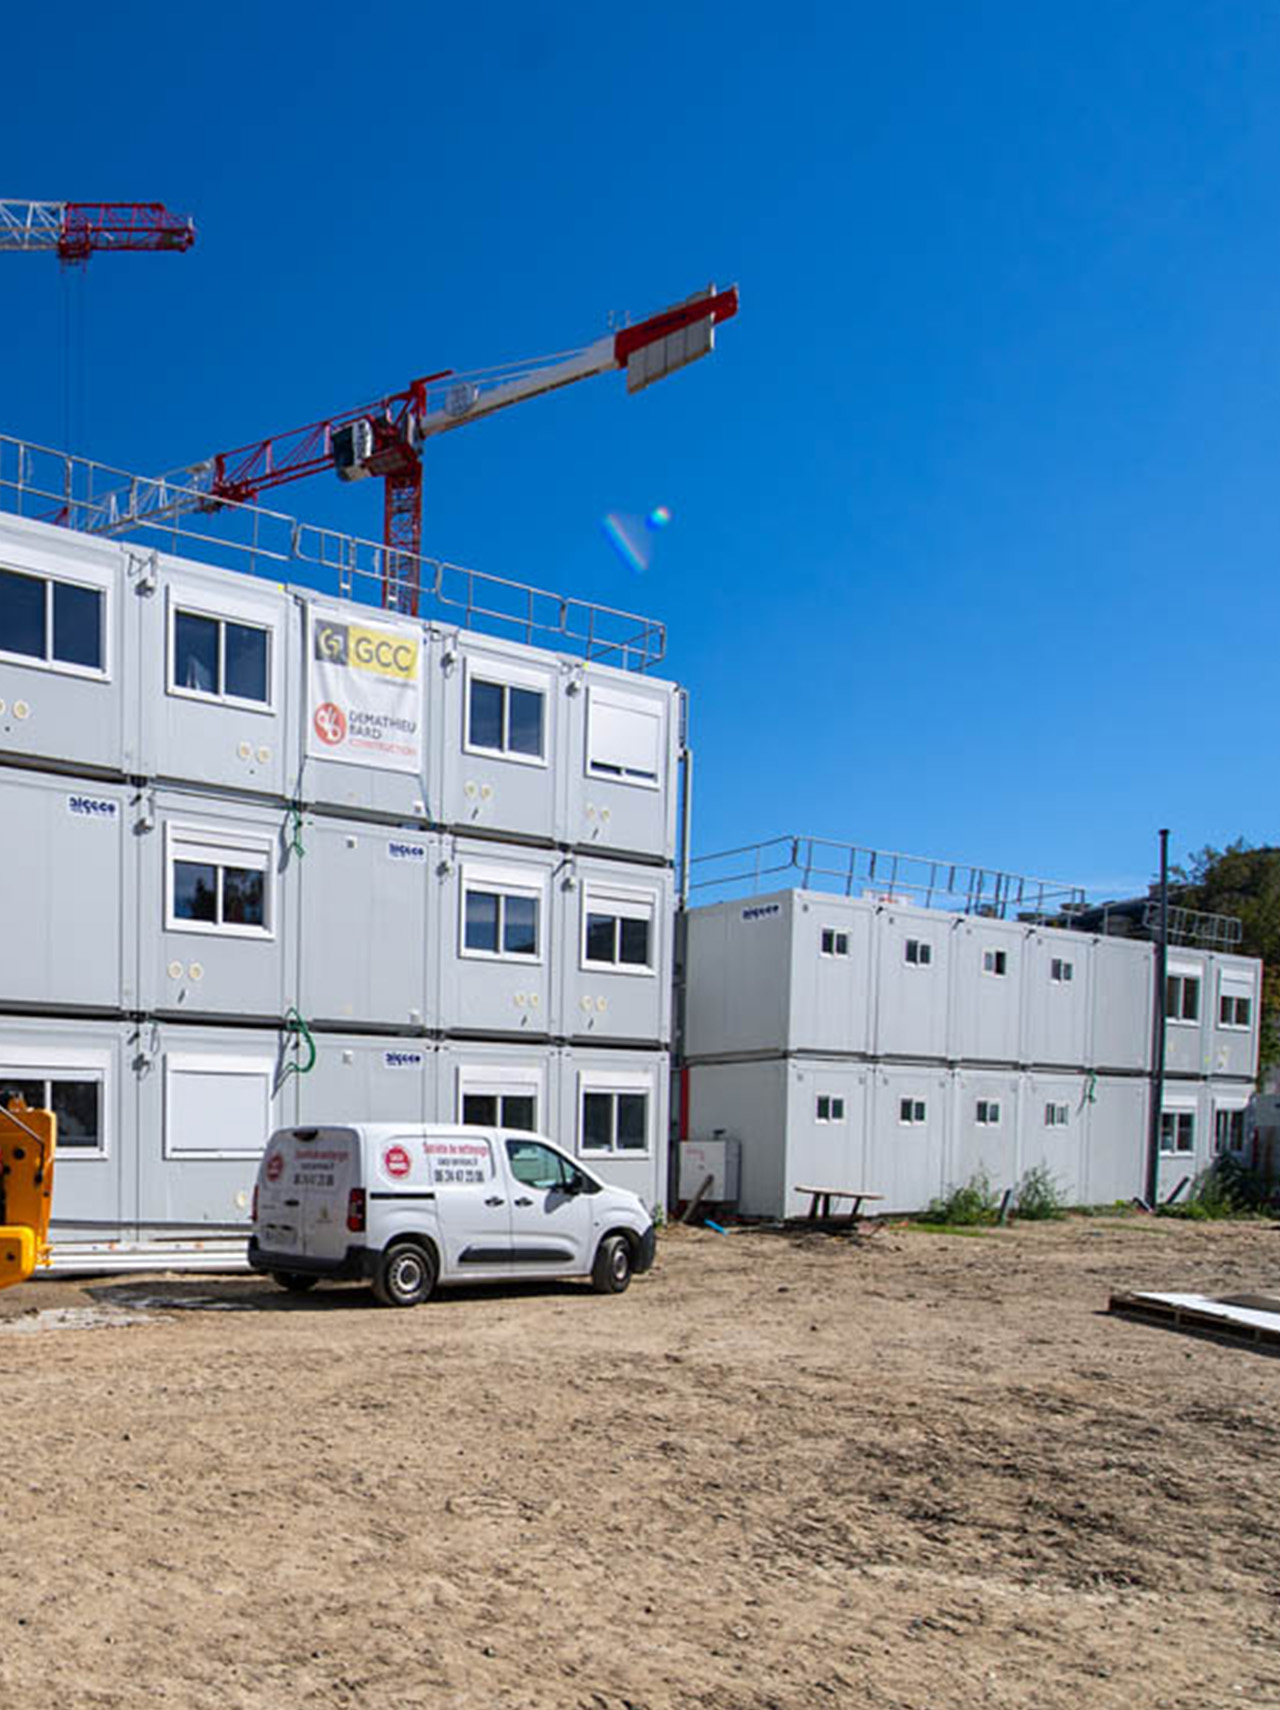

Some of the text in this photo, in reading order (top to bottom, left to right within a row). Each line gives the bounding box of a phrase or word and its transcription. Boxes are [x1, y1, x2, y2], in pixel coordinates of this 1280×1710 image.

[355, 636, 411, 672] GCC
[349, 710, 417, 733] DEMATHIEU
[349, 724, 382, 740] BARD
[69, 796, 116, 814] algeco
